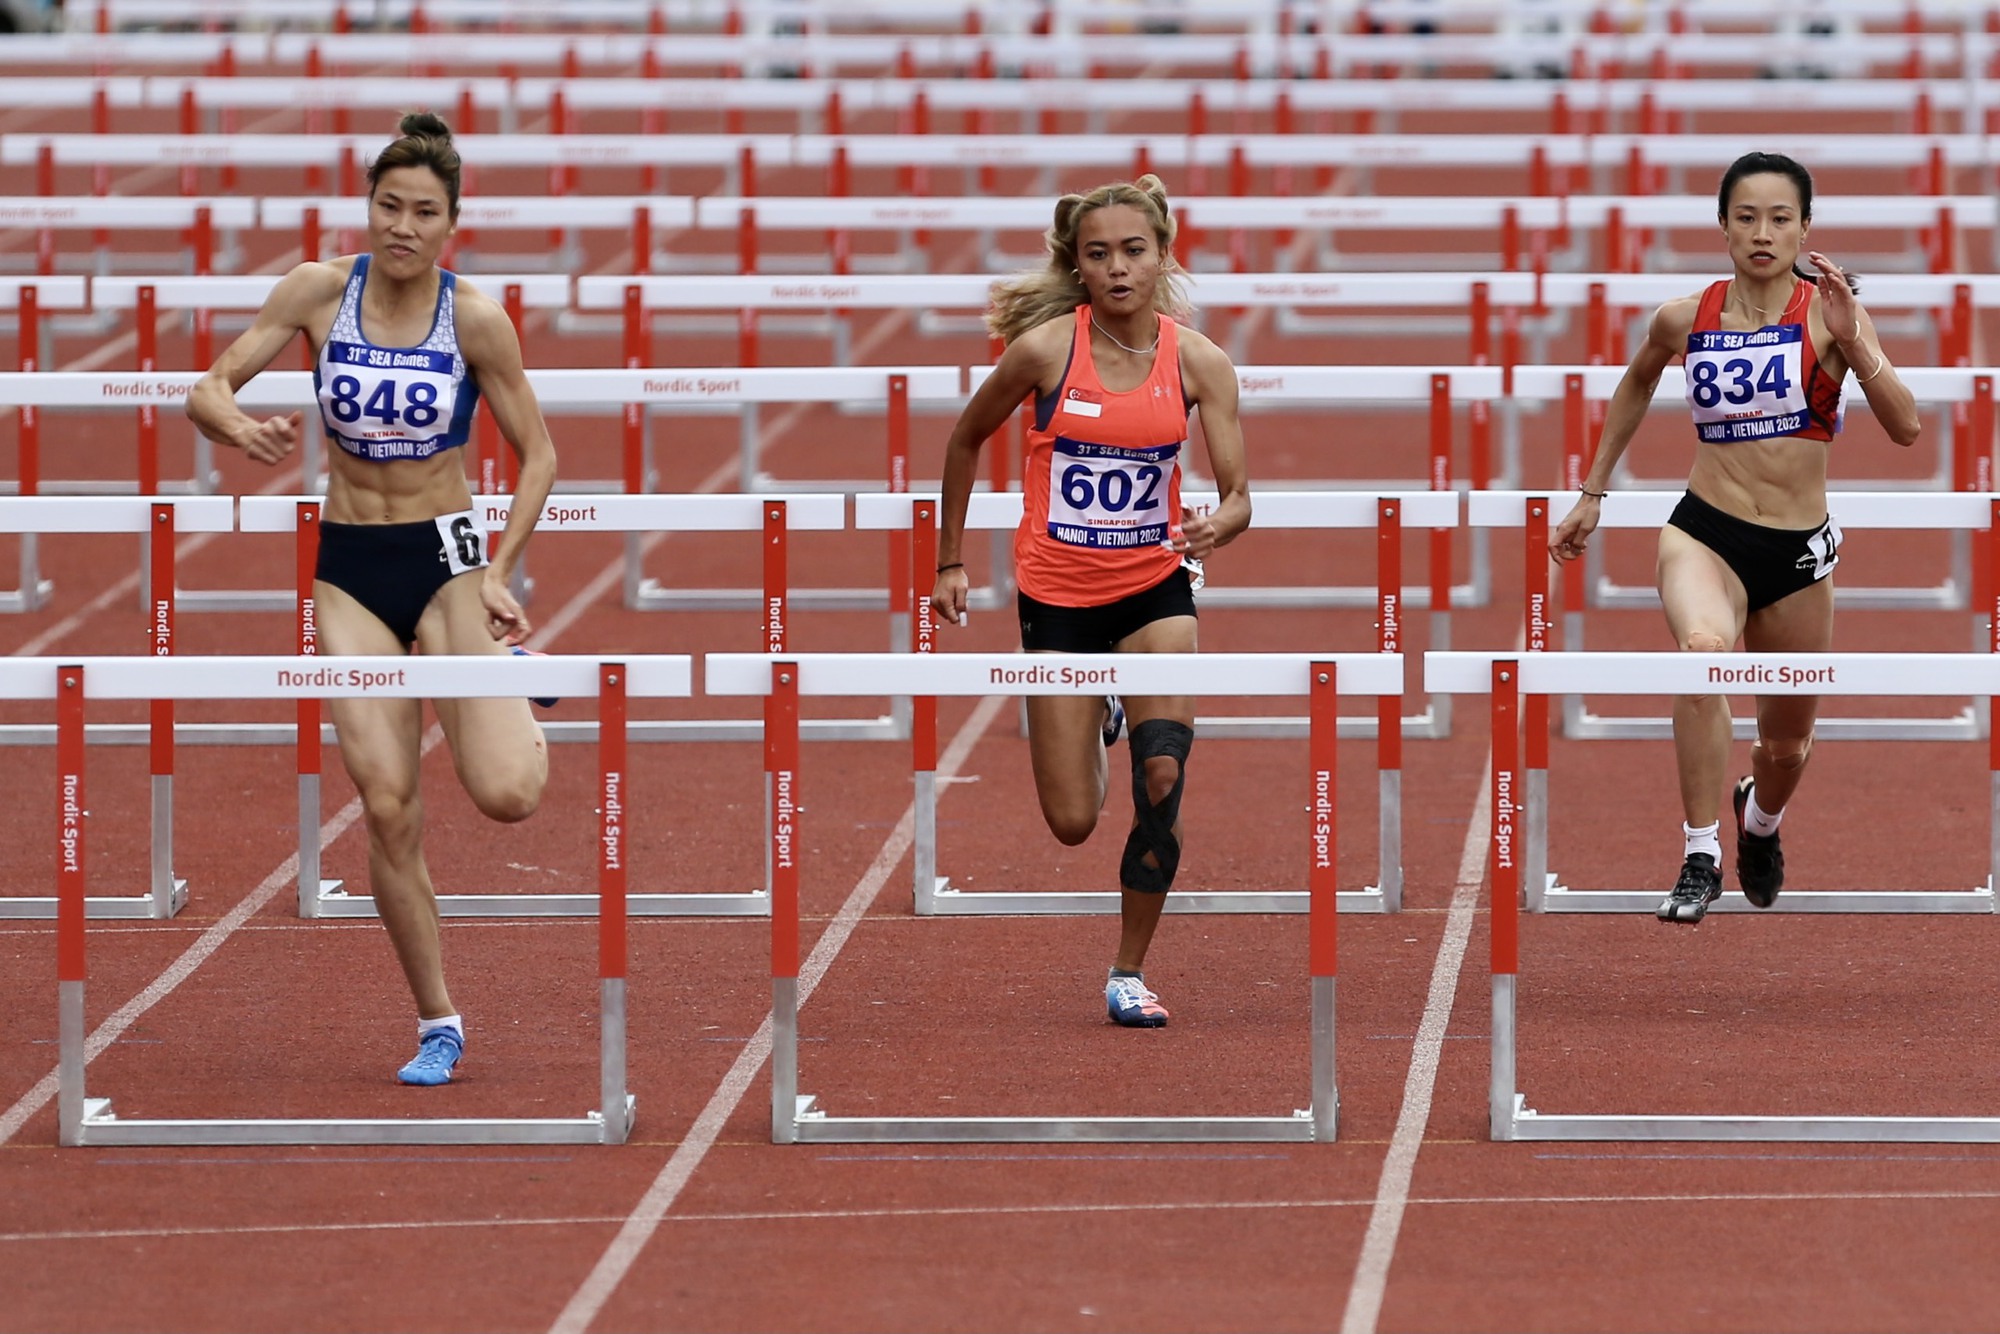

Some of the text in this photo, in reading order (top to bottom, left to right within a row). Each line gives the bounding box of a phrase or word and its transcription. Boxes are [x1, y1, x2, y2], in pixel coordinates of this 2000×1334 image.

[1723, 334, 1744, 348] SEA
[368, 348, 391, 367] SEA
[393, 353, 430, 368] Games
[156, 382, 193, 398] Spor
[697, 379, 741, 395] Sport
[1692, 354, 1792, 409] 834
[330, 374, 439, 428] 848
[1724, 410, 1764, 419] VIETNAM
[1703, 424, 1725, 439] HANOI
[1732, 420, 1775, 438] VIETNAM
[1776, 415, 1801, 432] 2022
[368, 442, 414, 459] VIETNAM
[1099, 446, 1121, 456] SEA
[1123, 449, 1160, 461] Games
[1061, 464, 1163, 512] 602
[547, 506, 596, 524] Sport
[1087, 518, 1137, 526] SINGAPORE
[450, 516, 481, 567] 6
[1057, 527, 1087, 544] HANOI
[1097, 529, 1138, 546] VIETNAM
[1140, 528, 1161, 543] 2022
[348, 669, 405, 691] Sport
[1060, 666, 1117, 688] Sport
[1778, 666, 1835, 688] Sport
[60, 828, 78, 872] Sport
[602, 825, 620, 870] Sport
[775, 824, 792, 868] Sport
[1313, 824, 1330, 868] Sport
[1495, 824, 1512, 868] Sport
